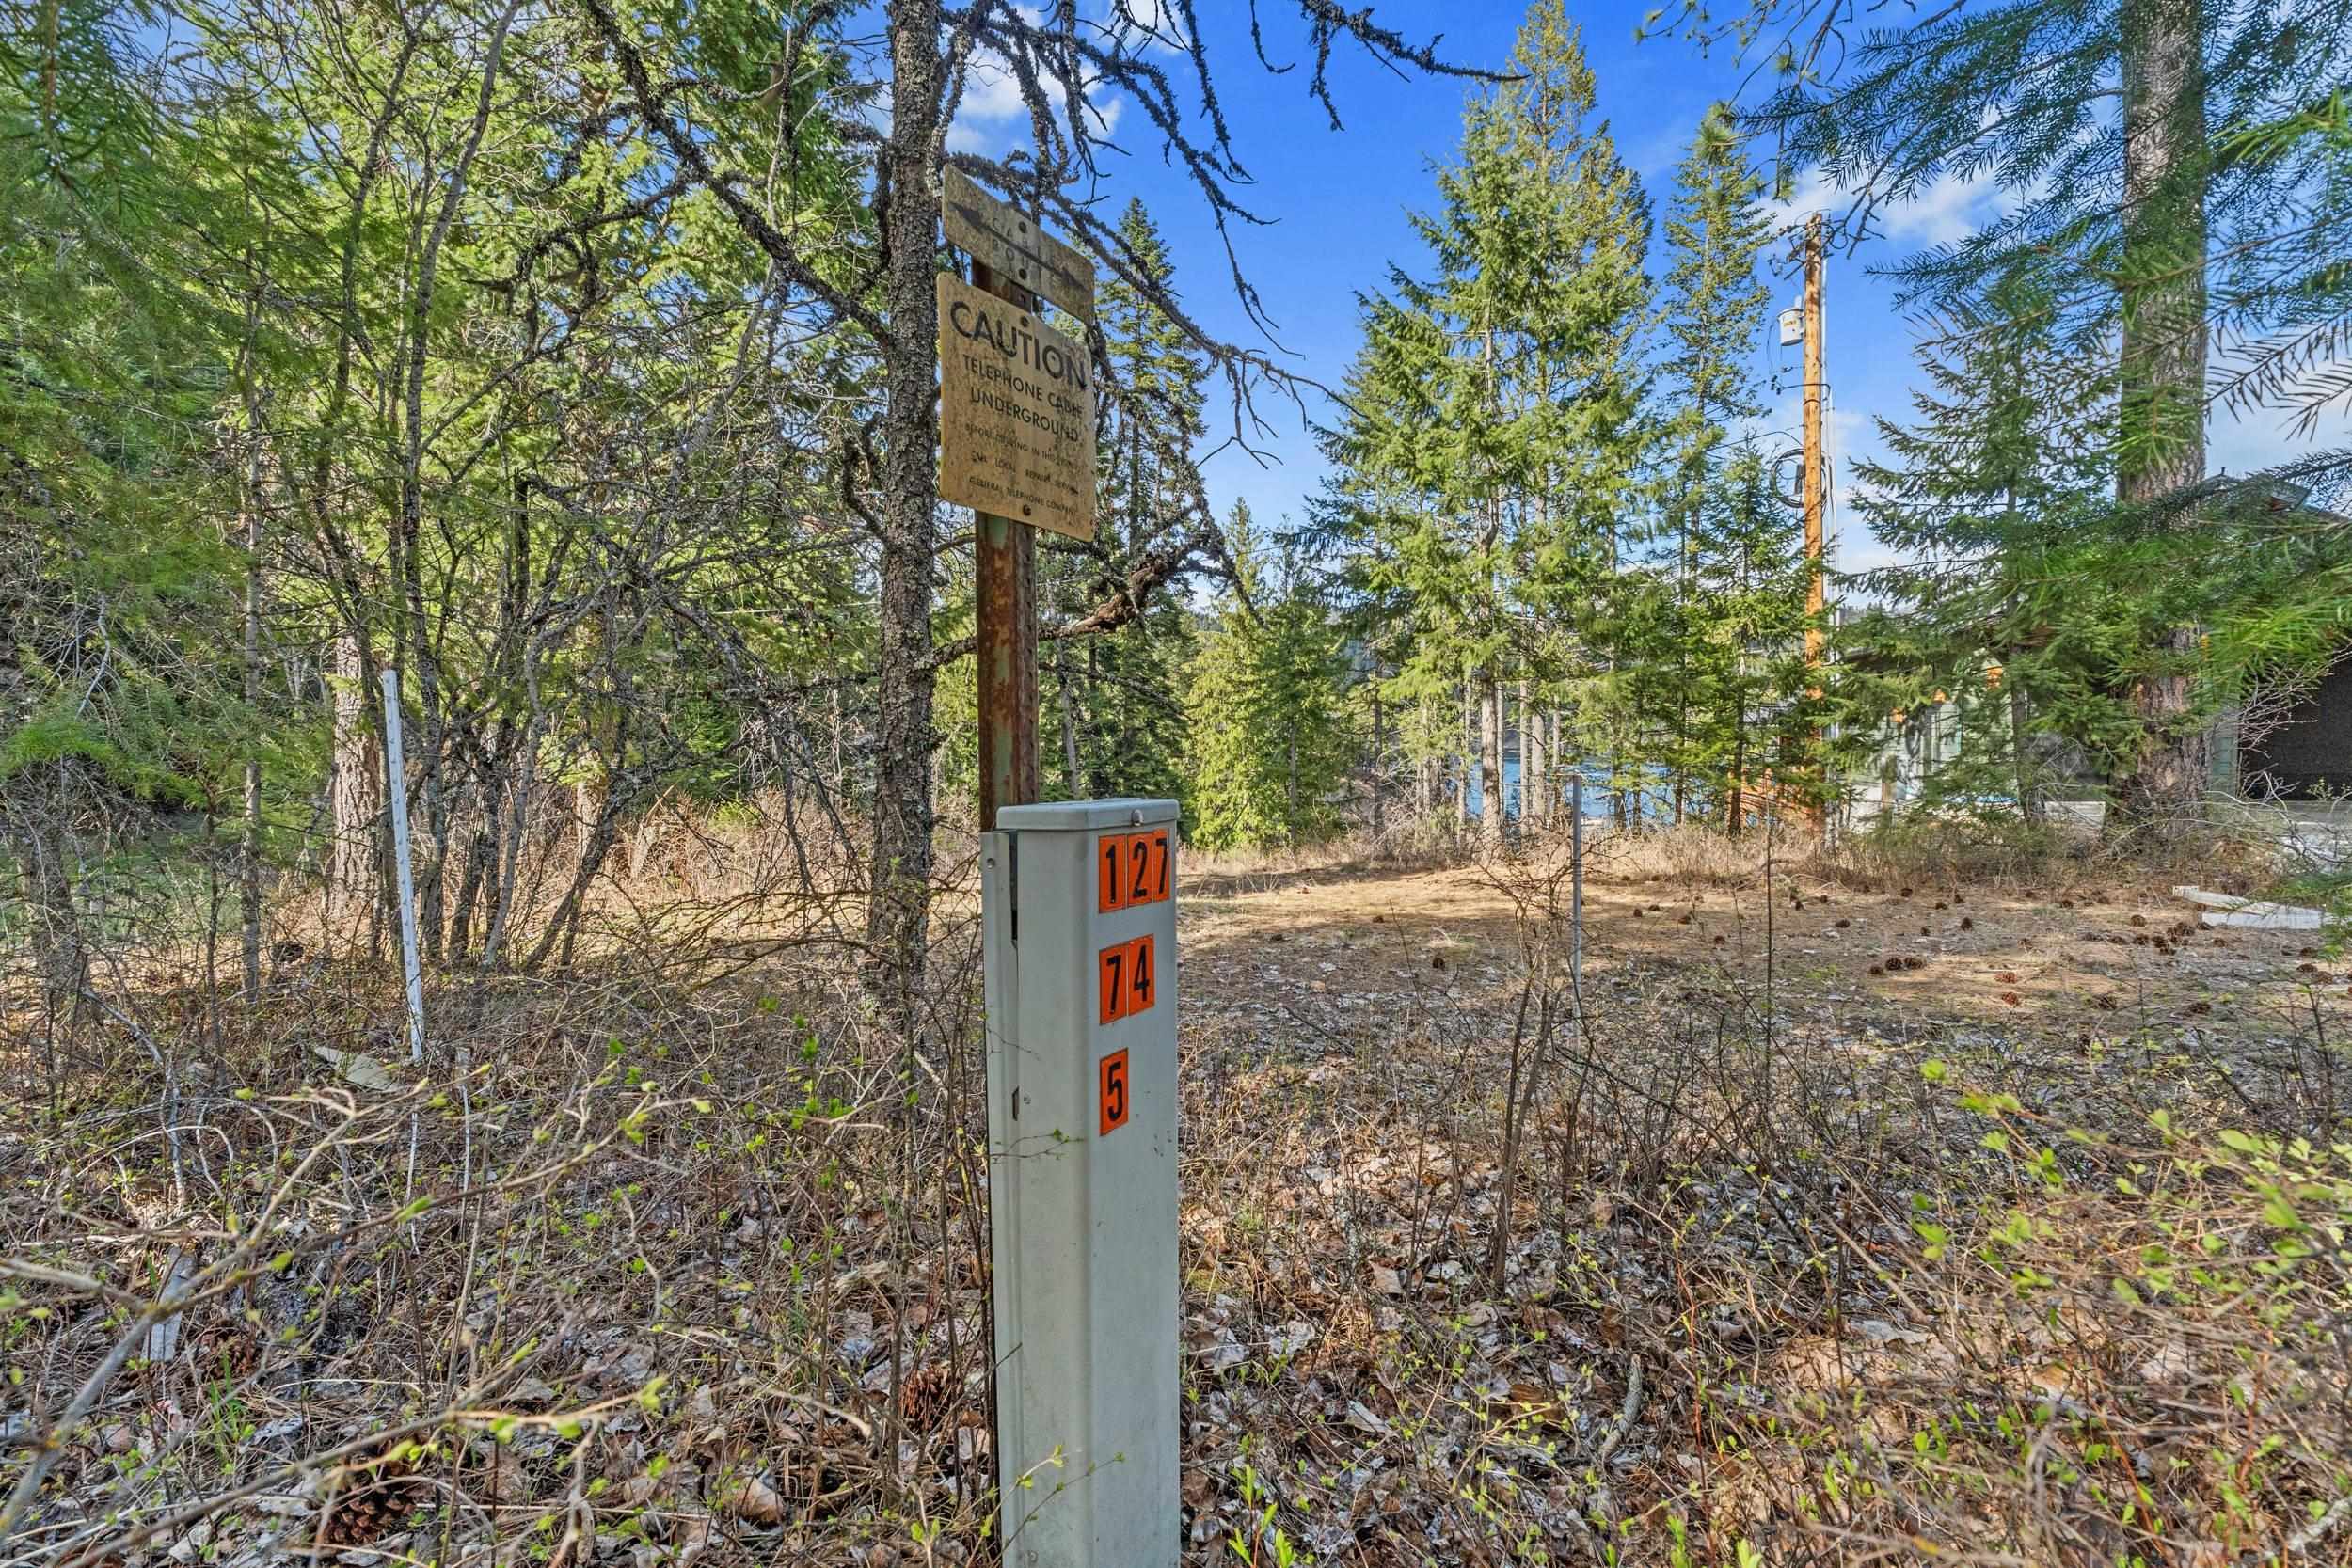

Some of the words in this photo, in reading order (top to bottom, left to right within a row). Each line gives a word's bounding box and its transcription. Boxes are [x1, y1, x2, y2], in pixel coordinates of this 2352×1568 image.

[949, 300, 1088, 391] CAUTION
[962, 354, 1043, 402] TELEPHONE
[970, 387, 1079, 442] UNDERGROUND
[1105, 837, 1168, 904] 127
[1106, 944, 1150, 1015] 74
[1107, 1060, 1123, 1122] 5
